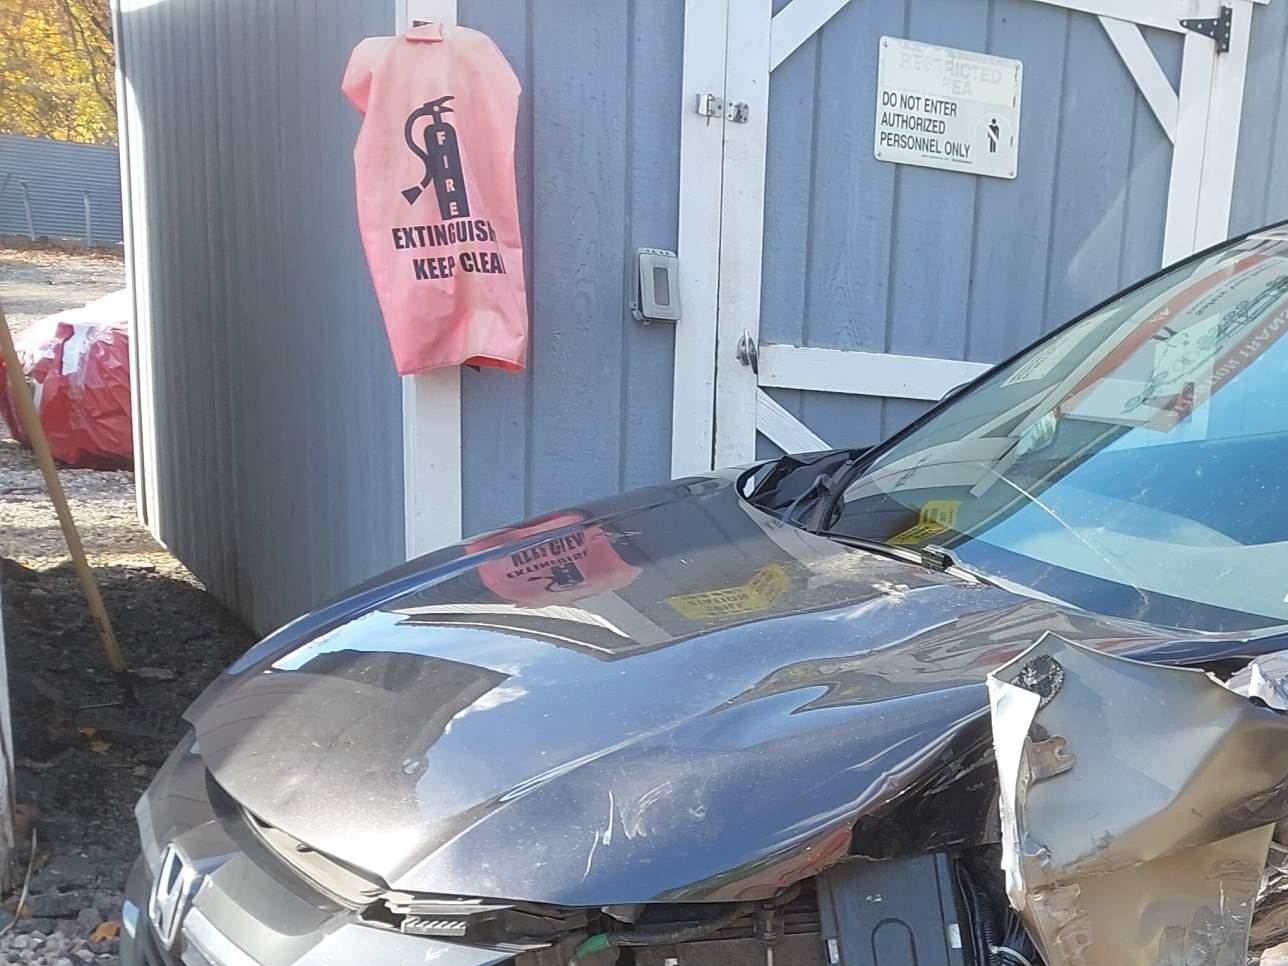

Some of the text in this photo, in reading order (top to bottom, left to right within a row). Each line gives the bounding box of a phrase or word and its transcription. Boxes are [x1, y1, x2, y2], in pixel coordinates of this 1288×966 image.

[882, 91, 957, 117] DO NOT ENTER
[880, 111, 946, 135] AUTHORIZED
[880, 131, 942, 154] PERSONNEL
[945, 141, 971, 159] ONLY
[435, 131, 459, 216] FIRE
[412, 251, 507, 280] KEEP CLEA
